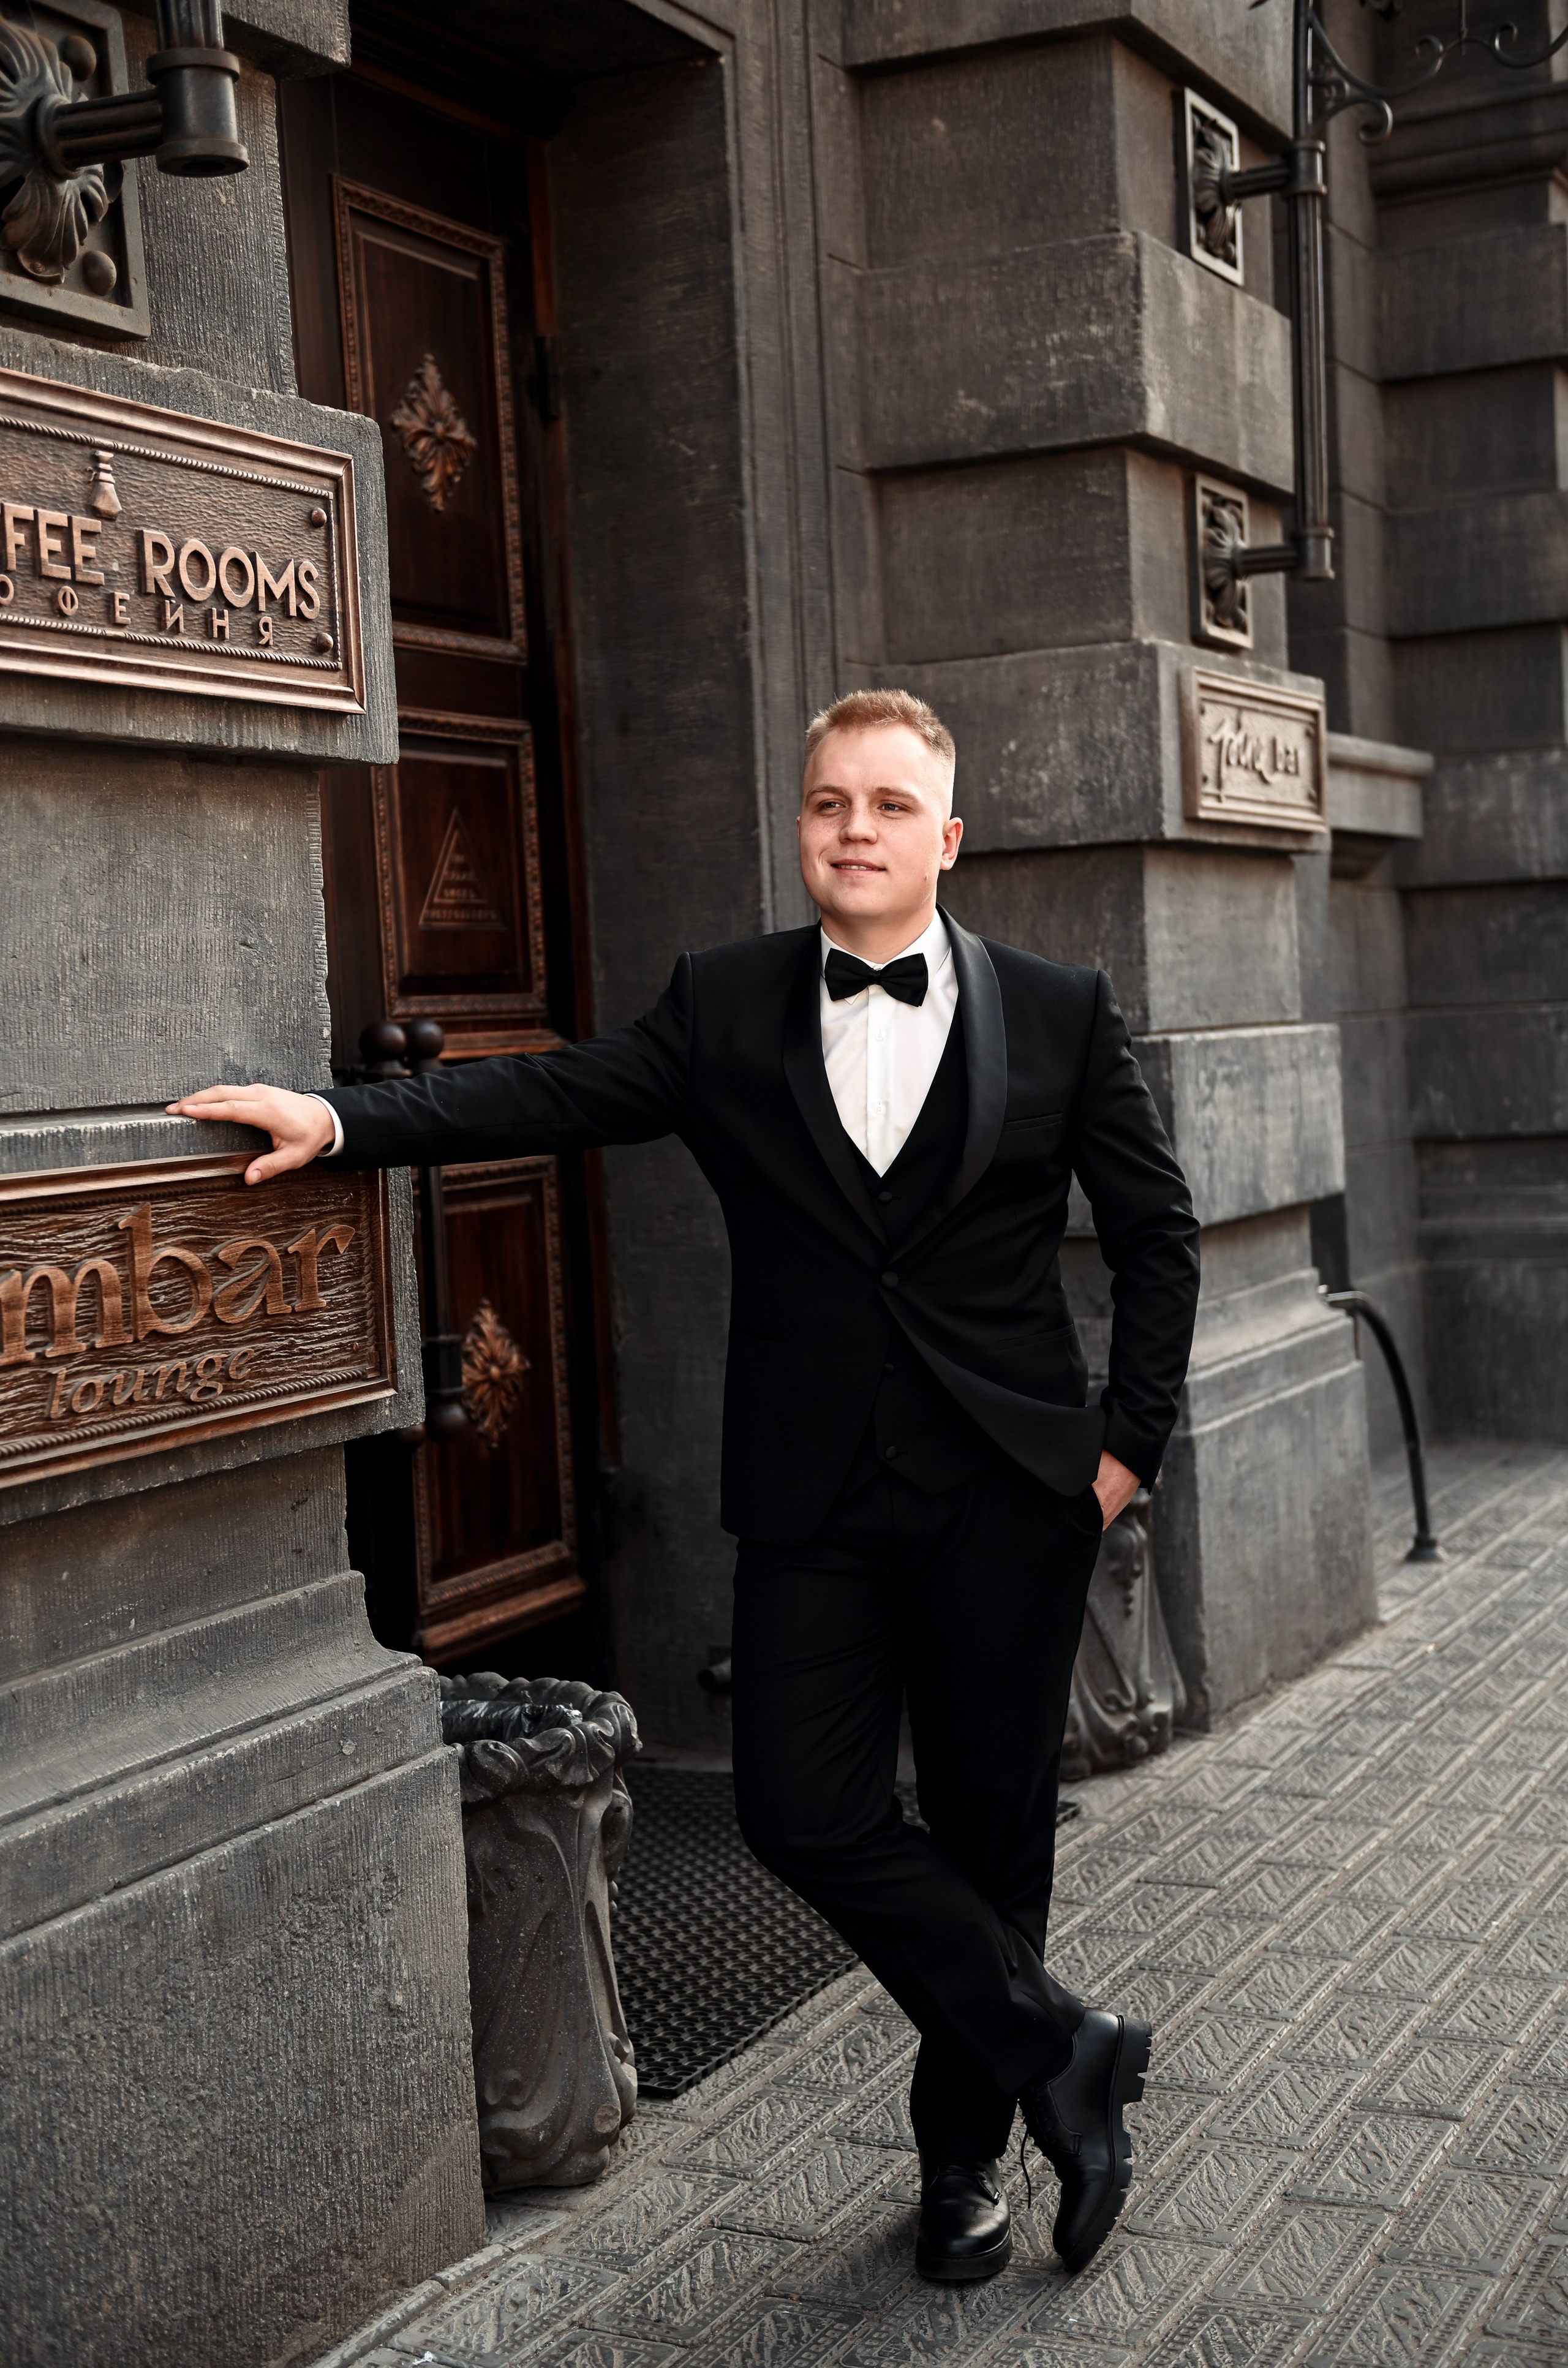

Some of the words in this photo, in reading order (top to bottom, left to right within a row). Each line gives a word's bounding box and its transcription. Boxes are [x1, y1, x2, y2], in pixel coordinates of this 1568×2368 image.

[141, 529, 322, 620] ROOMS
[0, 1201, 356, 1366] mbar
[49, 1348, 255, 1420] lounge
